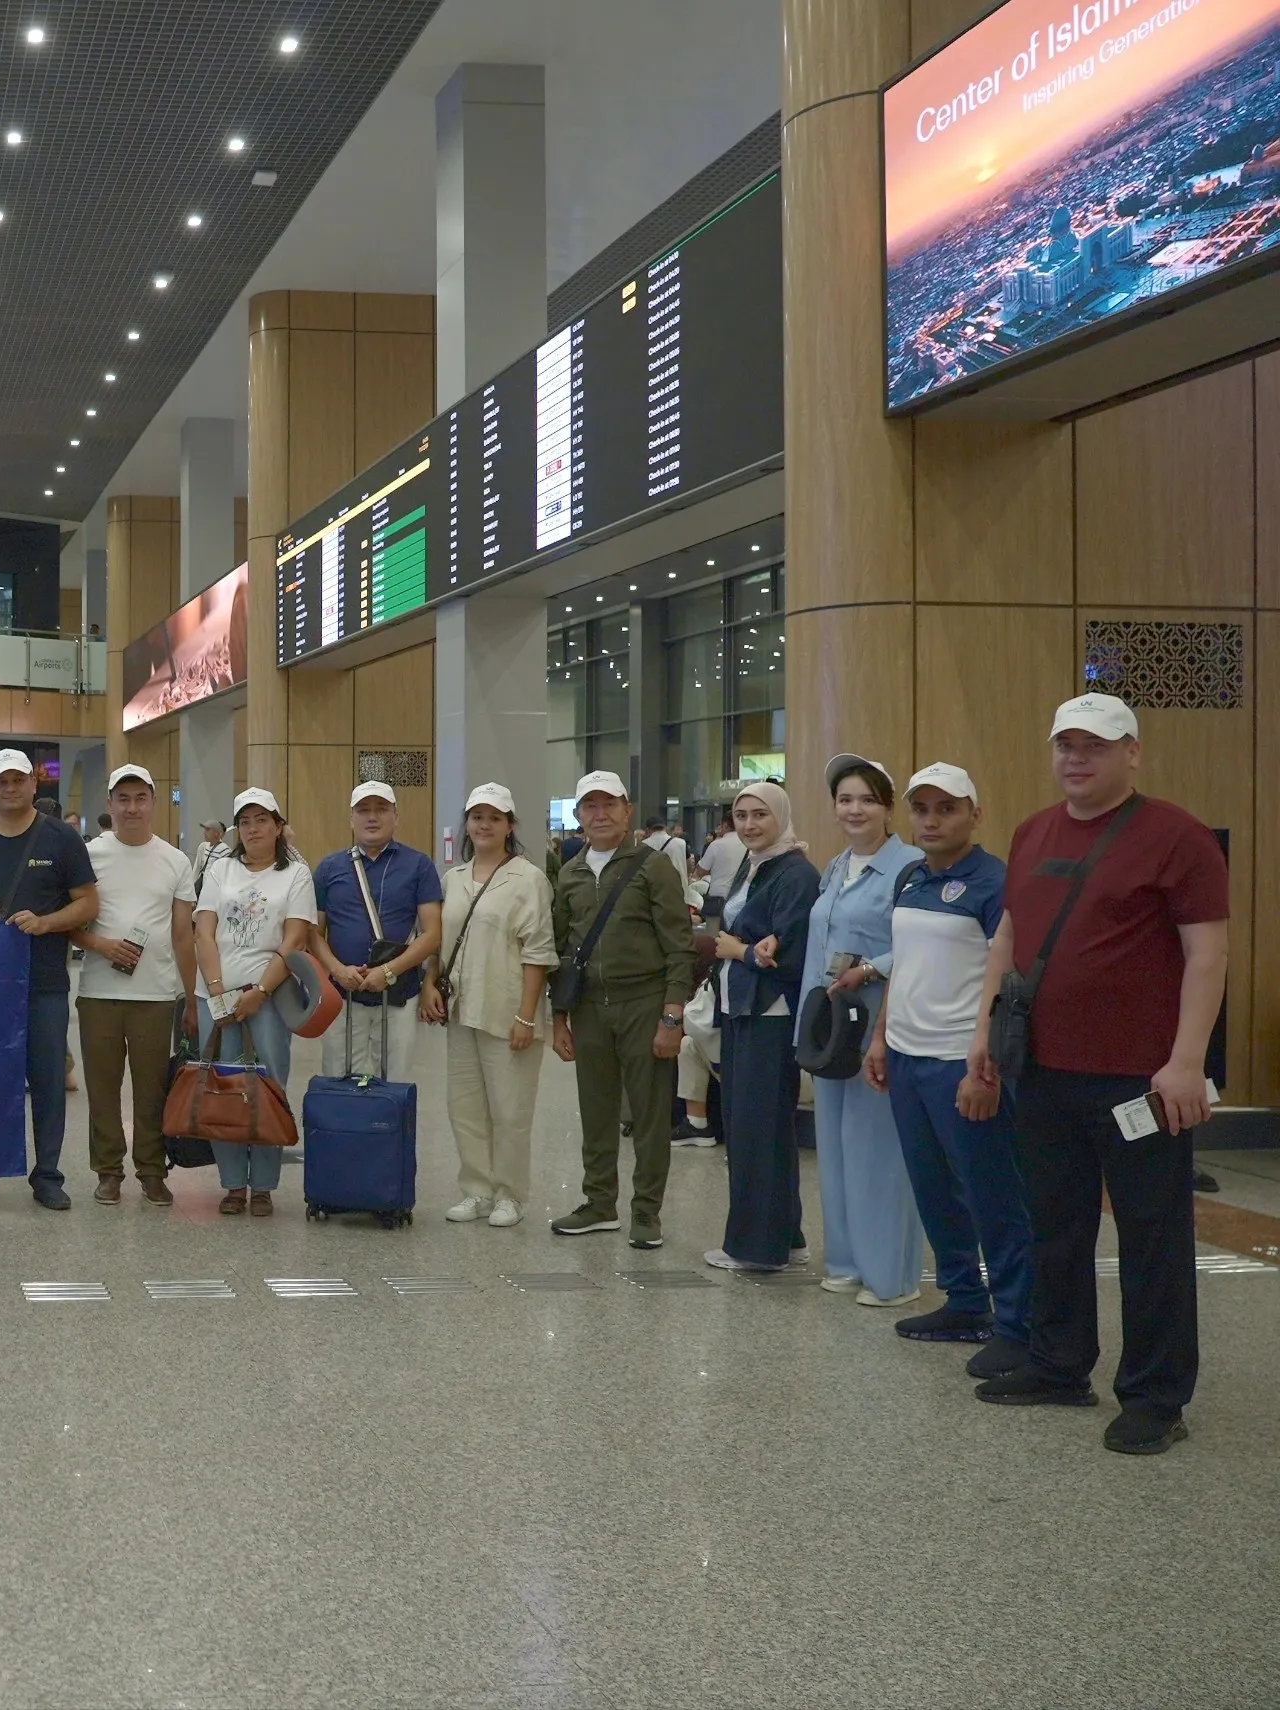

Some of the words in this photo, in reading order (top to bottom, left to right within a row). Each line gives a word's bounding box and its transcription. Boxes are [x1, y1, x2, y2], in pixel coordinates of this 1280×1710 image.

[916, 66, 1004, 143] Center
[1011, 30, 1040, 81] of
[1048, 0, 1139, 59] Isla
[1023, 55, 1095, 114] Inspiring
[1098, 0, 1200, 63] Generatio
